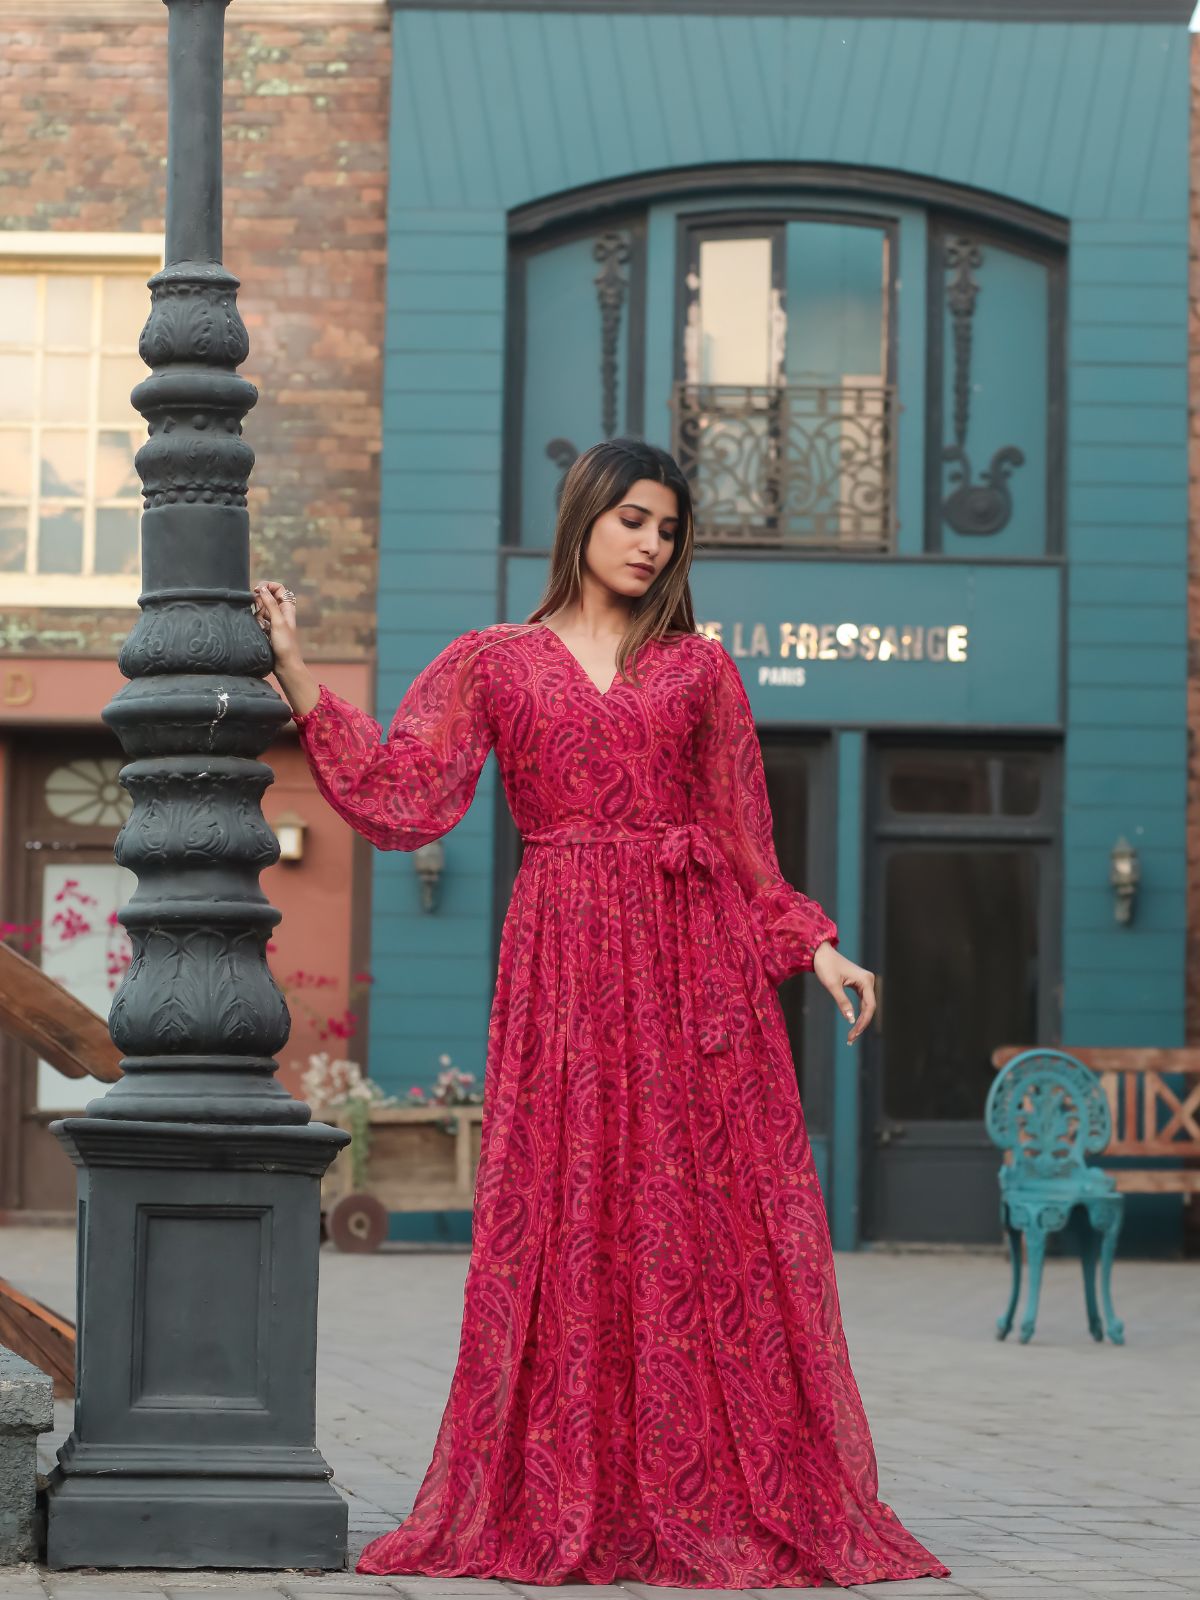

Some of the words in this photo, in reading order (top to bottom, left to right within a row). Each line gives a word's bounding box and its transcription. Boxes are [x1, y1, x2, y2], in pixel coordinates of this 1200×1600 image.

[696, 622, 722, 641] E
[733, 623, 770, 657] LA
[780, 623, 968, 661] FRESSANGE
[758, 667, 806, 686] PARIS
